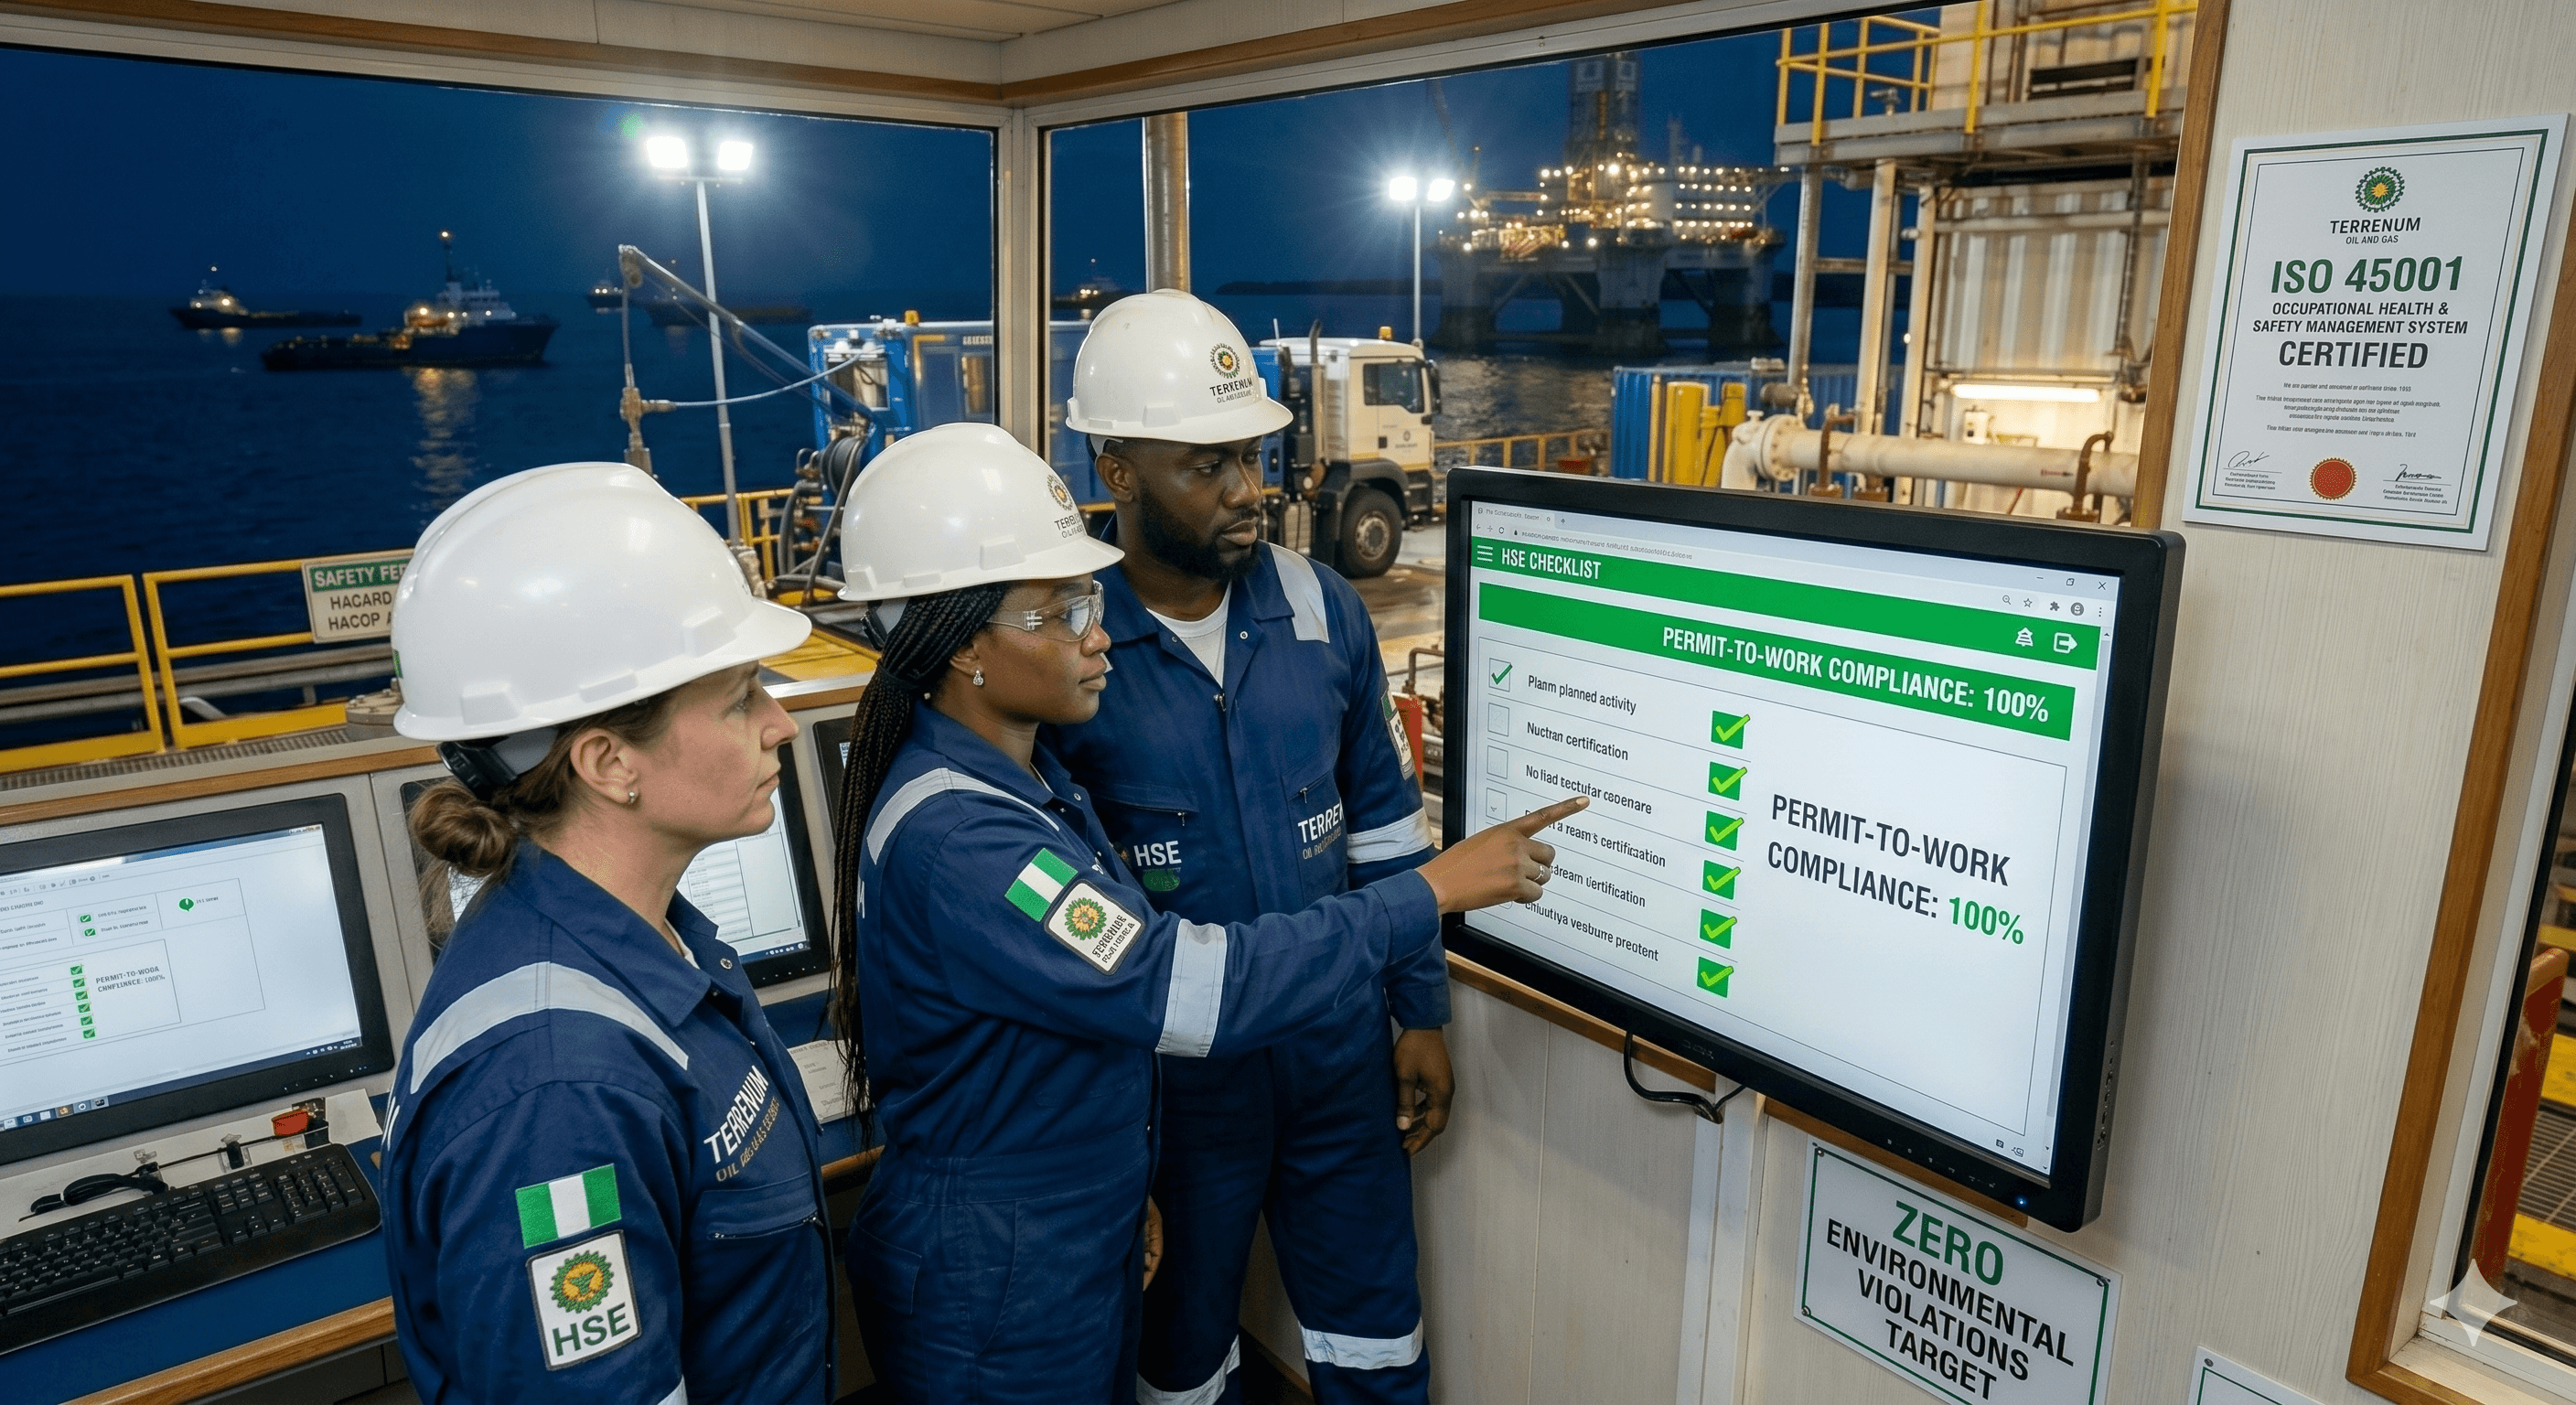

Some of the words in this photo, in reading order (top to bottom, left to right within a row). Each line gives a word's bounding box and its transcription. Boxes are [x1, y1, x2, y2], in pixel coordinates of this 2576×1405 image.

[2330, 217, 2421, 234] TERRENUM
[2345, 235, 2359, 244] OIL
[2361, 235, 2379, 244] AND
[2381, 234, 2399, 243] GAS
[2270, 259, 2333, 294] ISO
[2345, 256, 2463, 293] 45001
[2272, 303, 2374, 316] OCCUPATIONAL
[2378, 302, 2434, 316] HEALTH
[2438, 302, 2449, 316] &
[2252, 320, 2302, 333] SAFETY
[2305, 321, 2404, 334] MANAGEMENT
[2408, 321, 2468, 334] SYSTEM
[2279, 341, 2429, 369] CERTIFIED
[314, 565, 374, 587] SAFETY
[1501, 548, 1526, 567] HSE
[1530, 552, 1601, 580] CHECKLIST
[330, 591, 392, 610] HACARD
[327, 612, 381, 631] HACOP
[1663, 627, 1822, 678] PERMIT-TO-WORK
[1829, 658, 1974, 708] COMPLIANCE:
[1983, 687, 2049, 723] 100%
[1559, 684, 1597, 702] planned
[1599, 695, 1637, 715] activity
[1566, 735, 1628, 760] certification
[1526, 765, 1539, 779] No
[1133, 840, 1182, 866] HSE
[1772, 794, 2011, 886] PERMIT-TO-WORK
[1767, 841, 1938, 918] COMPLIANCE:
[1949, 896, 2024, 945] 100%
[715, 1163, 739, 1182] OIL
[1892, 1200, 2004, 1286] ZERO
[1827, 1217, 2075, 1367] ENVIRONMENTAL
[552, 1303, 630, 1357] HSE
[1858, 1268, 2030, 1381] VIOLATIONS
[1884, 1318, 1998, 1400] TARGET
